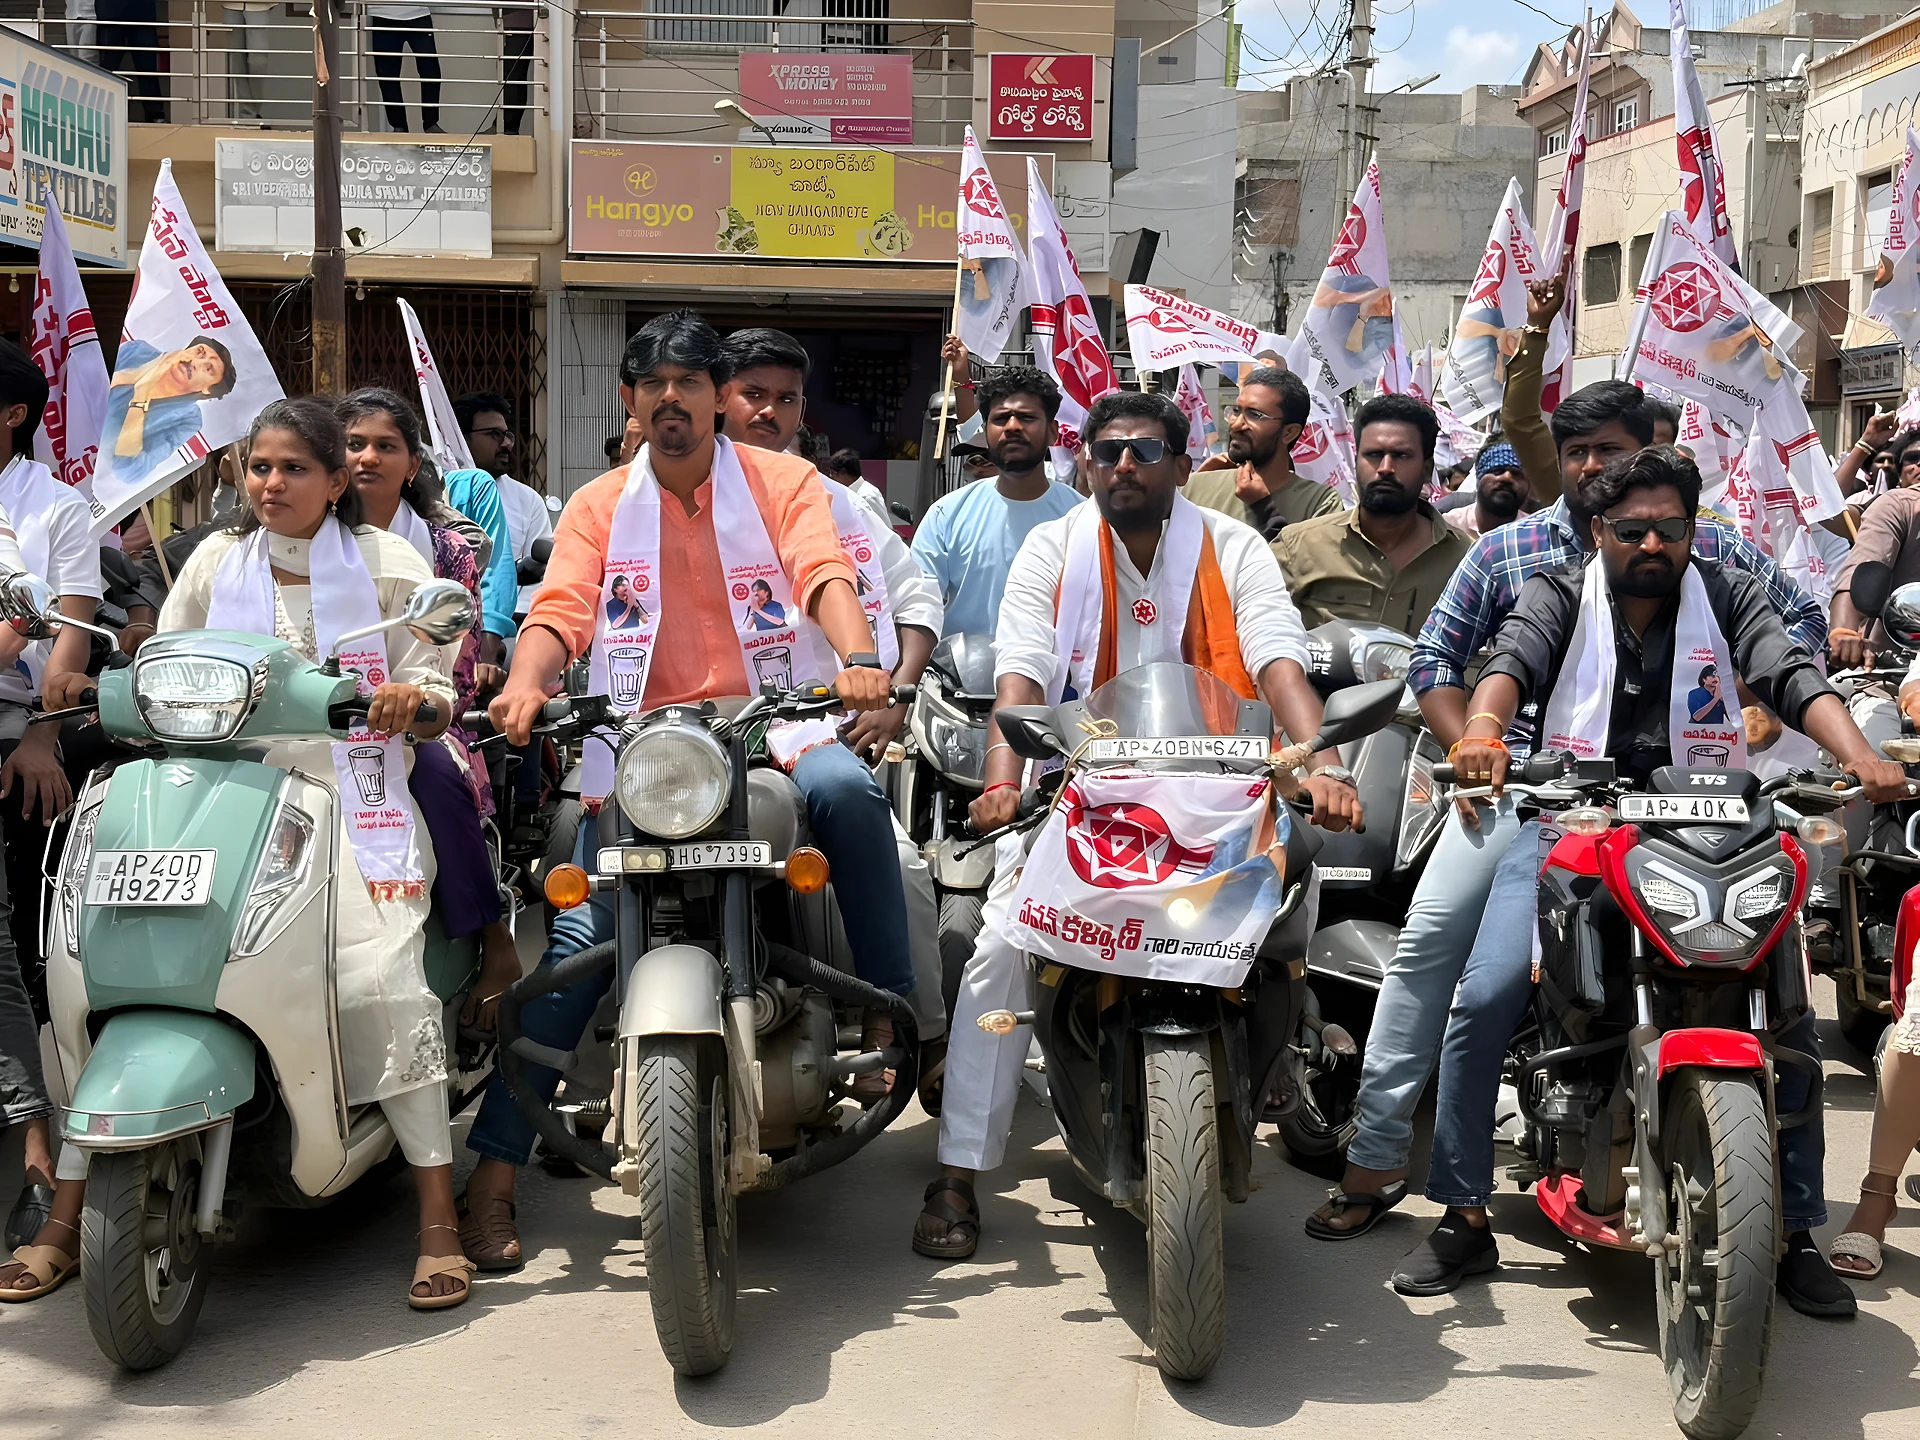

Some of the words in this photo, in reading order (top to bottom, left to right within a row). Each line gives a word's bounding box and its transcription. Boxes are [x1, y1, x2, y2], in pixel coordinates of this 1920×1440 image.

[21, 82, 111, 176] MADHU
[998, 103, 1037, 132] గోల్డ్
[1042, 104, 1085, 131] లోన్స్
[22, 158, 117, 228] TEXTILES
[586, 195, 694, 226] Hangyo
[1689, 774, 1728, 786] TVS
[1646, 799, 1669, 816] AP
[713, 846, 762, 863] 7399
[107, 878, 196, 901] H9273
